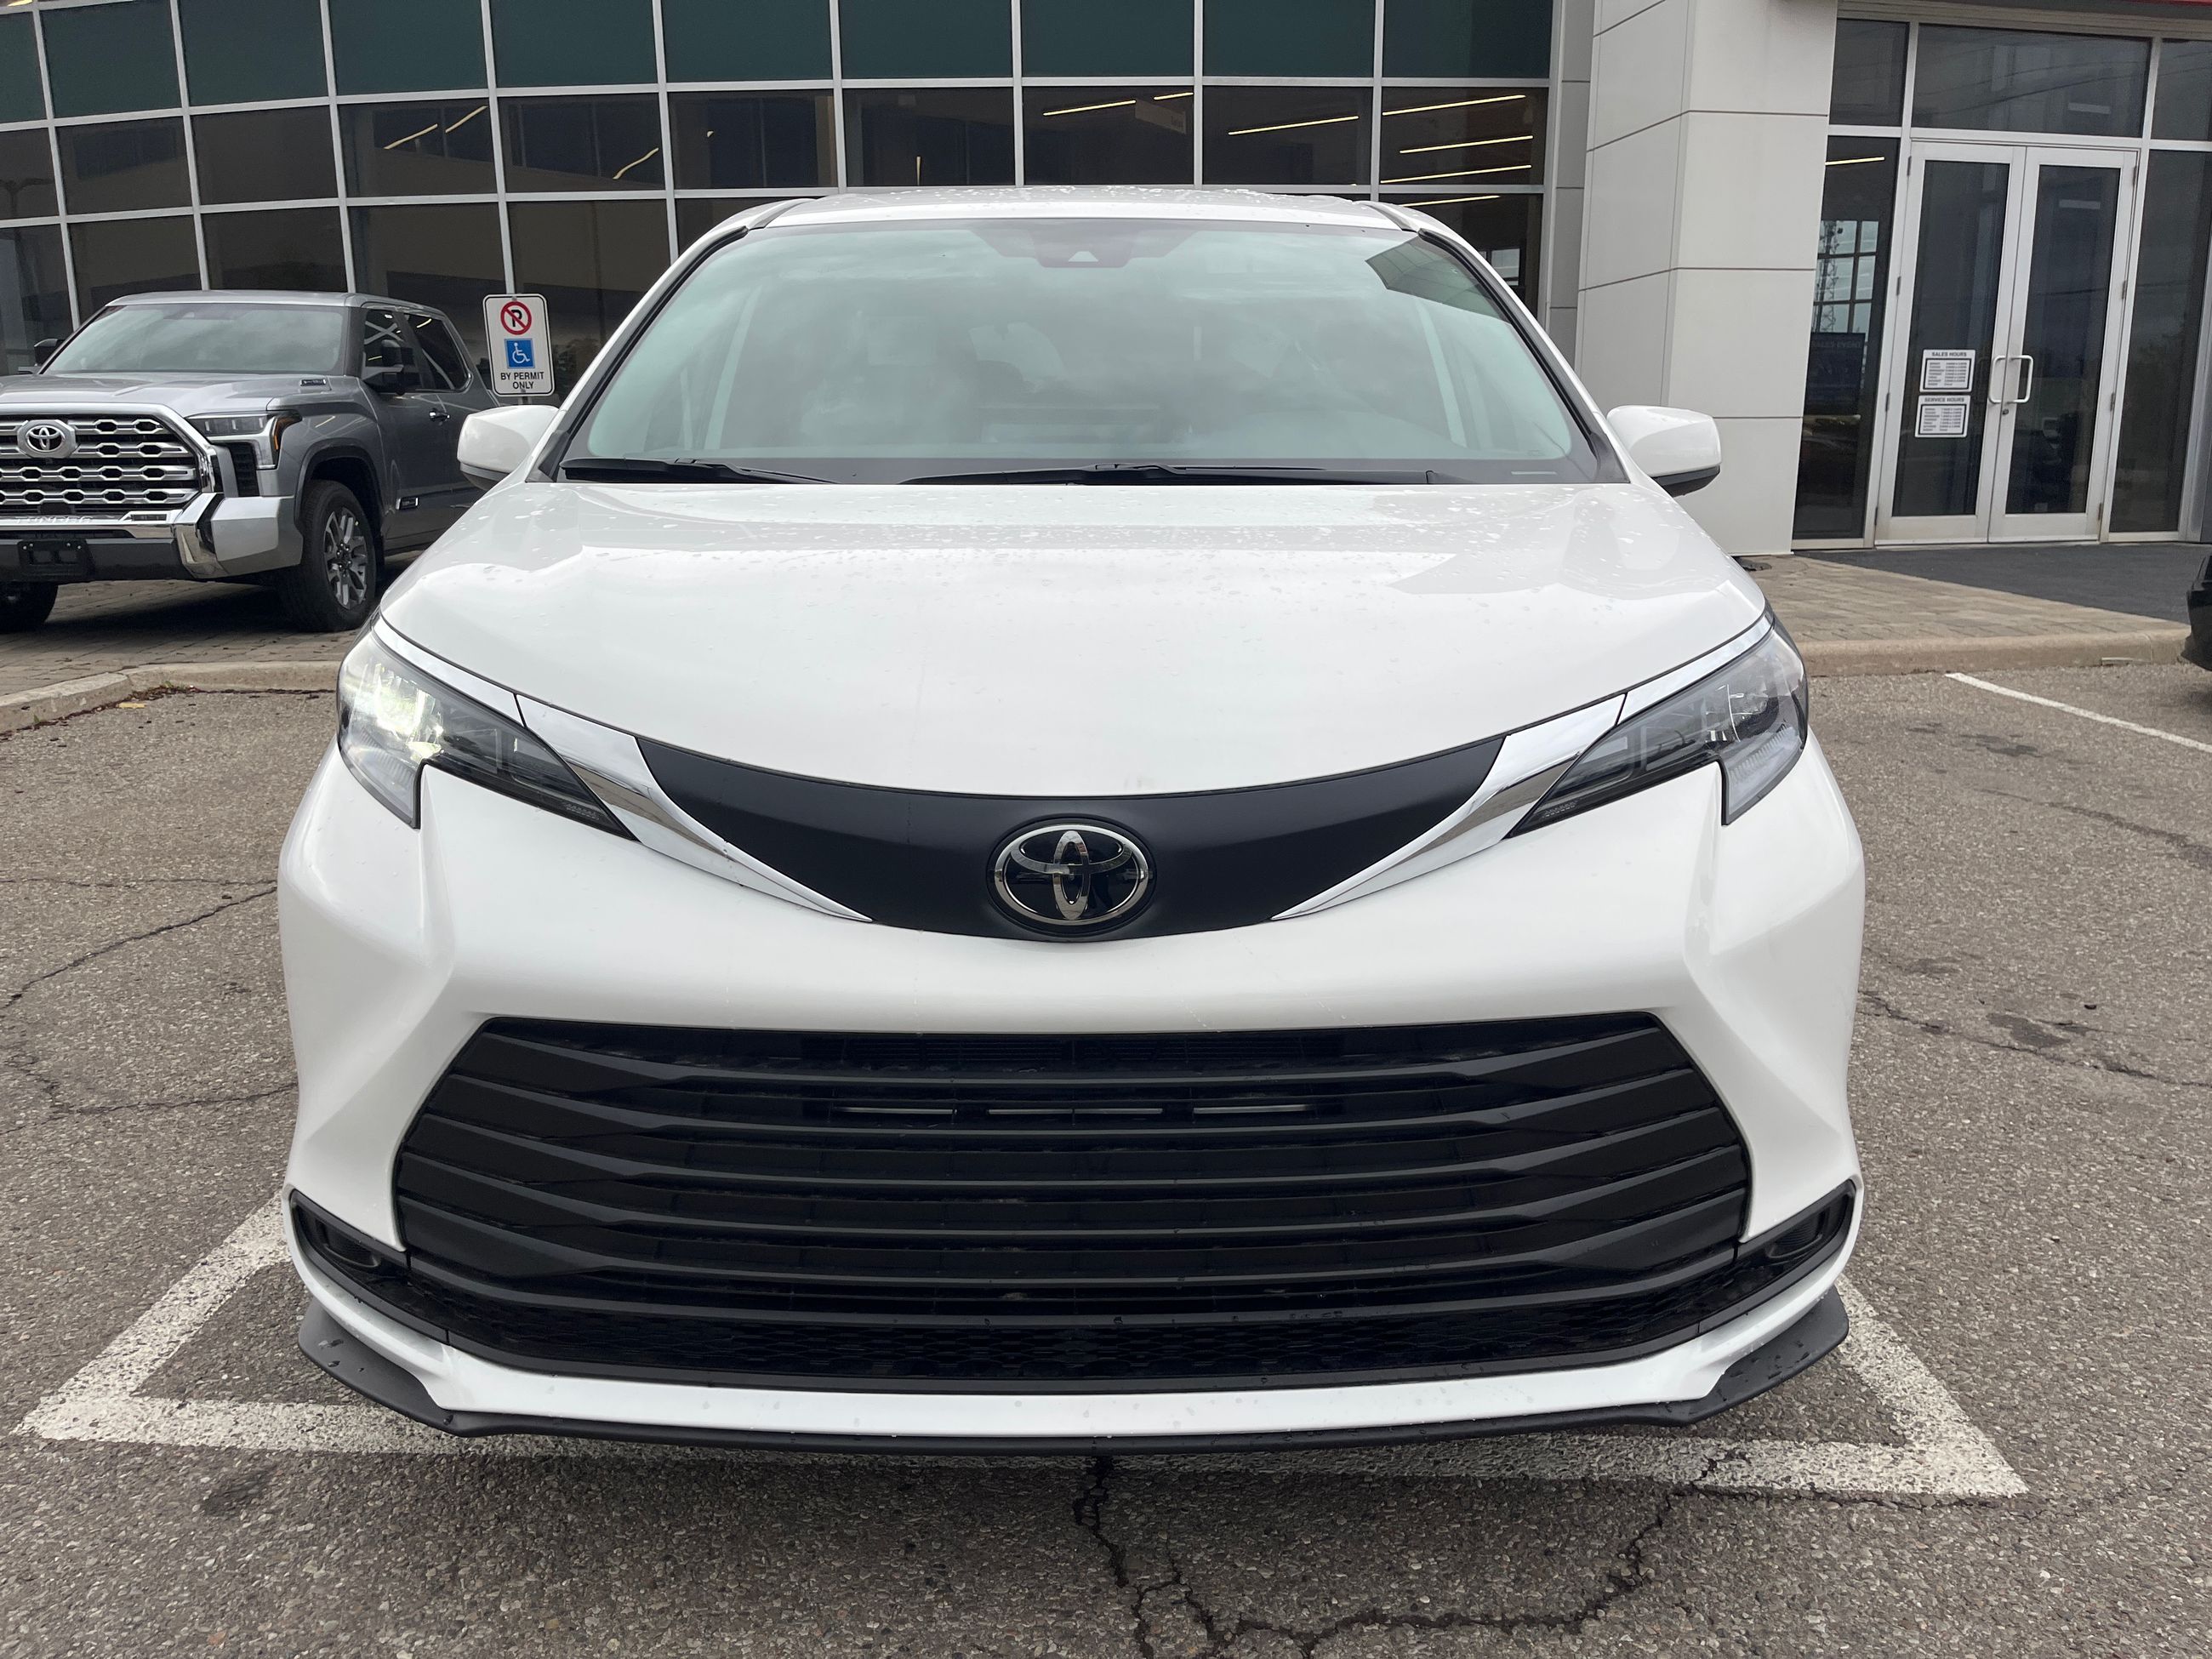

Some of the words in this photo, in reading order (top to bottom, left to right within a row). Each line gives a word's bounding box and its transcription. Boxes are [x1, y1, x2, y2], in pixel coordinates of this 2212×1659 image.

[510, 309, 522, 328] P
[500, 372, 511, 380] BY
[514, 371, 544, 380] PERMIT
[512, 381, 534, 390] ONLY
